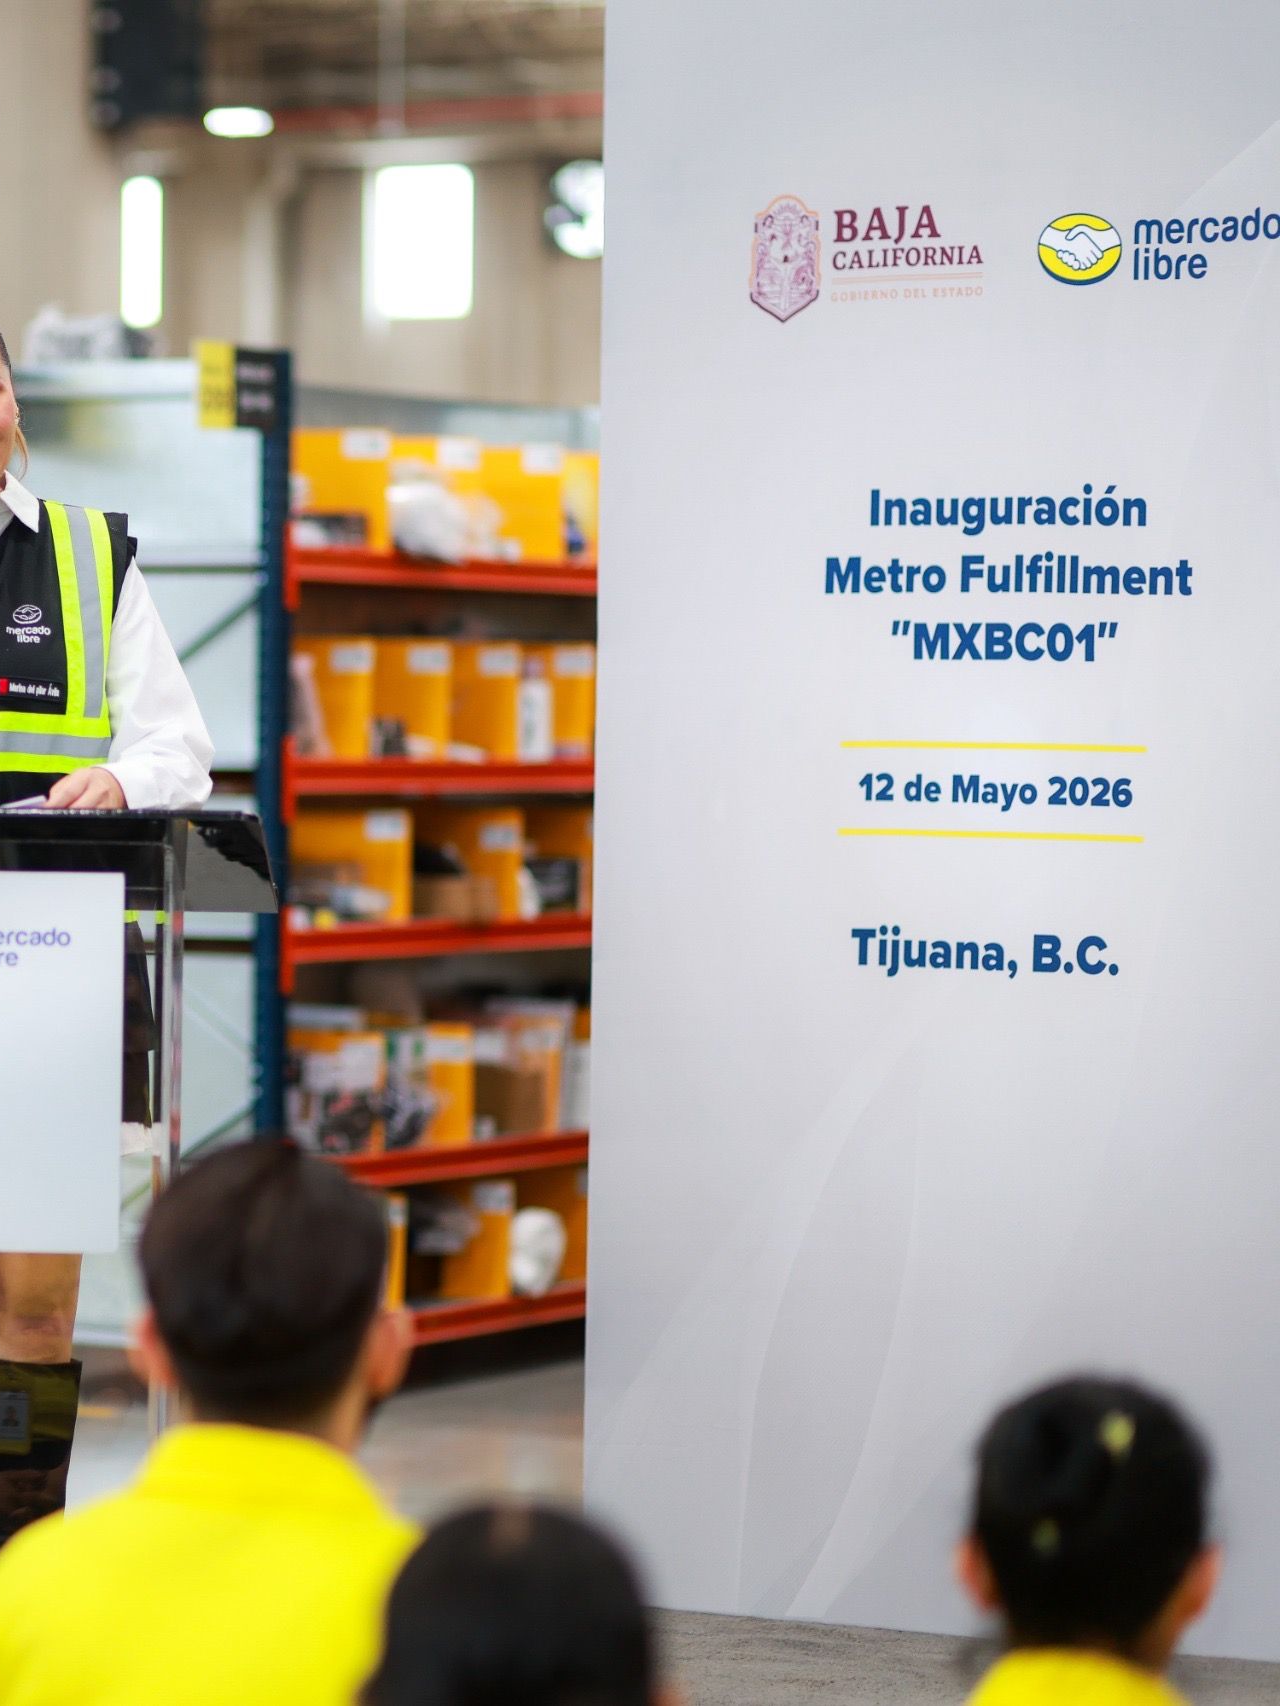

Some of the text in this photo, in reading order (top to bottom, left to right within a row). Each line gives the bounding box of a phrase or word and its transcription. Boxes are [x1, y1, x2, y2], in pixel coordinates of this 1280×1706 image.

[834, 205, 941, 245] BAJA
[1134, 207, 1280, 244] mercado
[833, 245, 984, 270] CALIFORNIA
[1133, 248, 1207, 280] libre
[831, 286, 984, 302] GOBIERNO DEL ESTADO
[870, 483, 1147, 536] Inauguración
[825, 551, 1193, 596] Metro Fulfillment
[6, 625, 52, 636] mercado
[16, 635, 41, 644] libre
[892, 620, 1118, 662] "MXBC01"
[859, 773, 1132, 812] 12 de Mayo 2026
[851, 925, 1119, 979] Tijuana, B.C.
